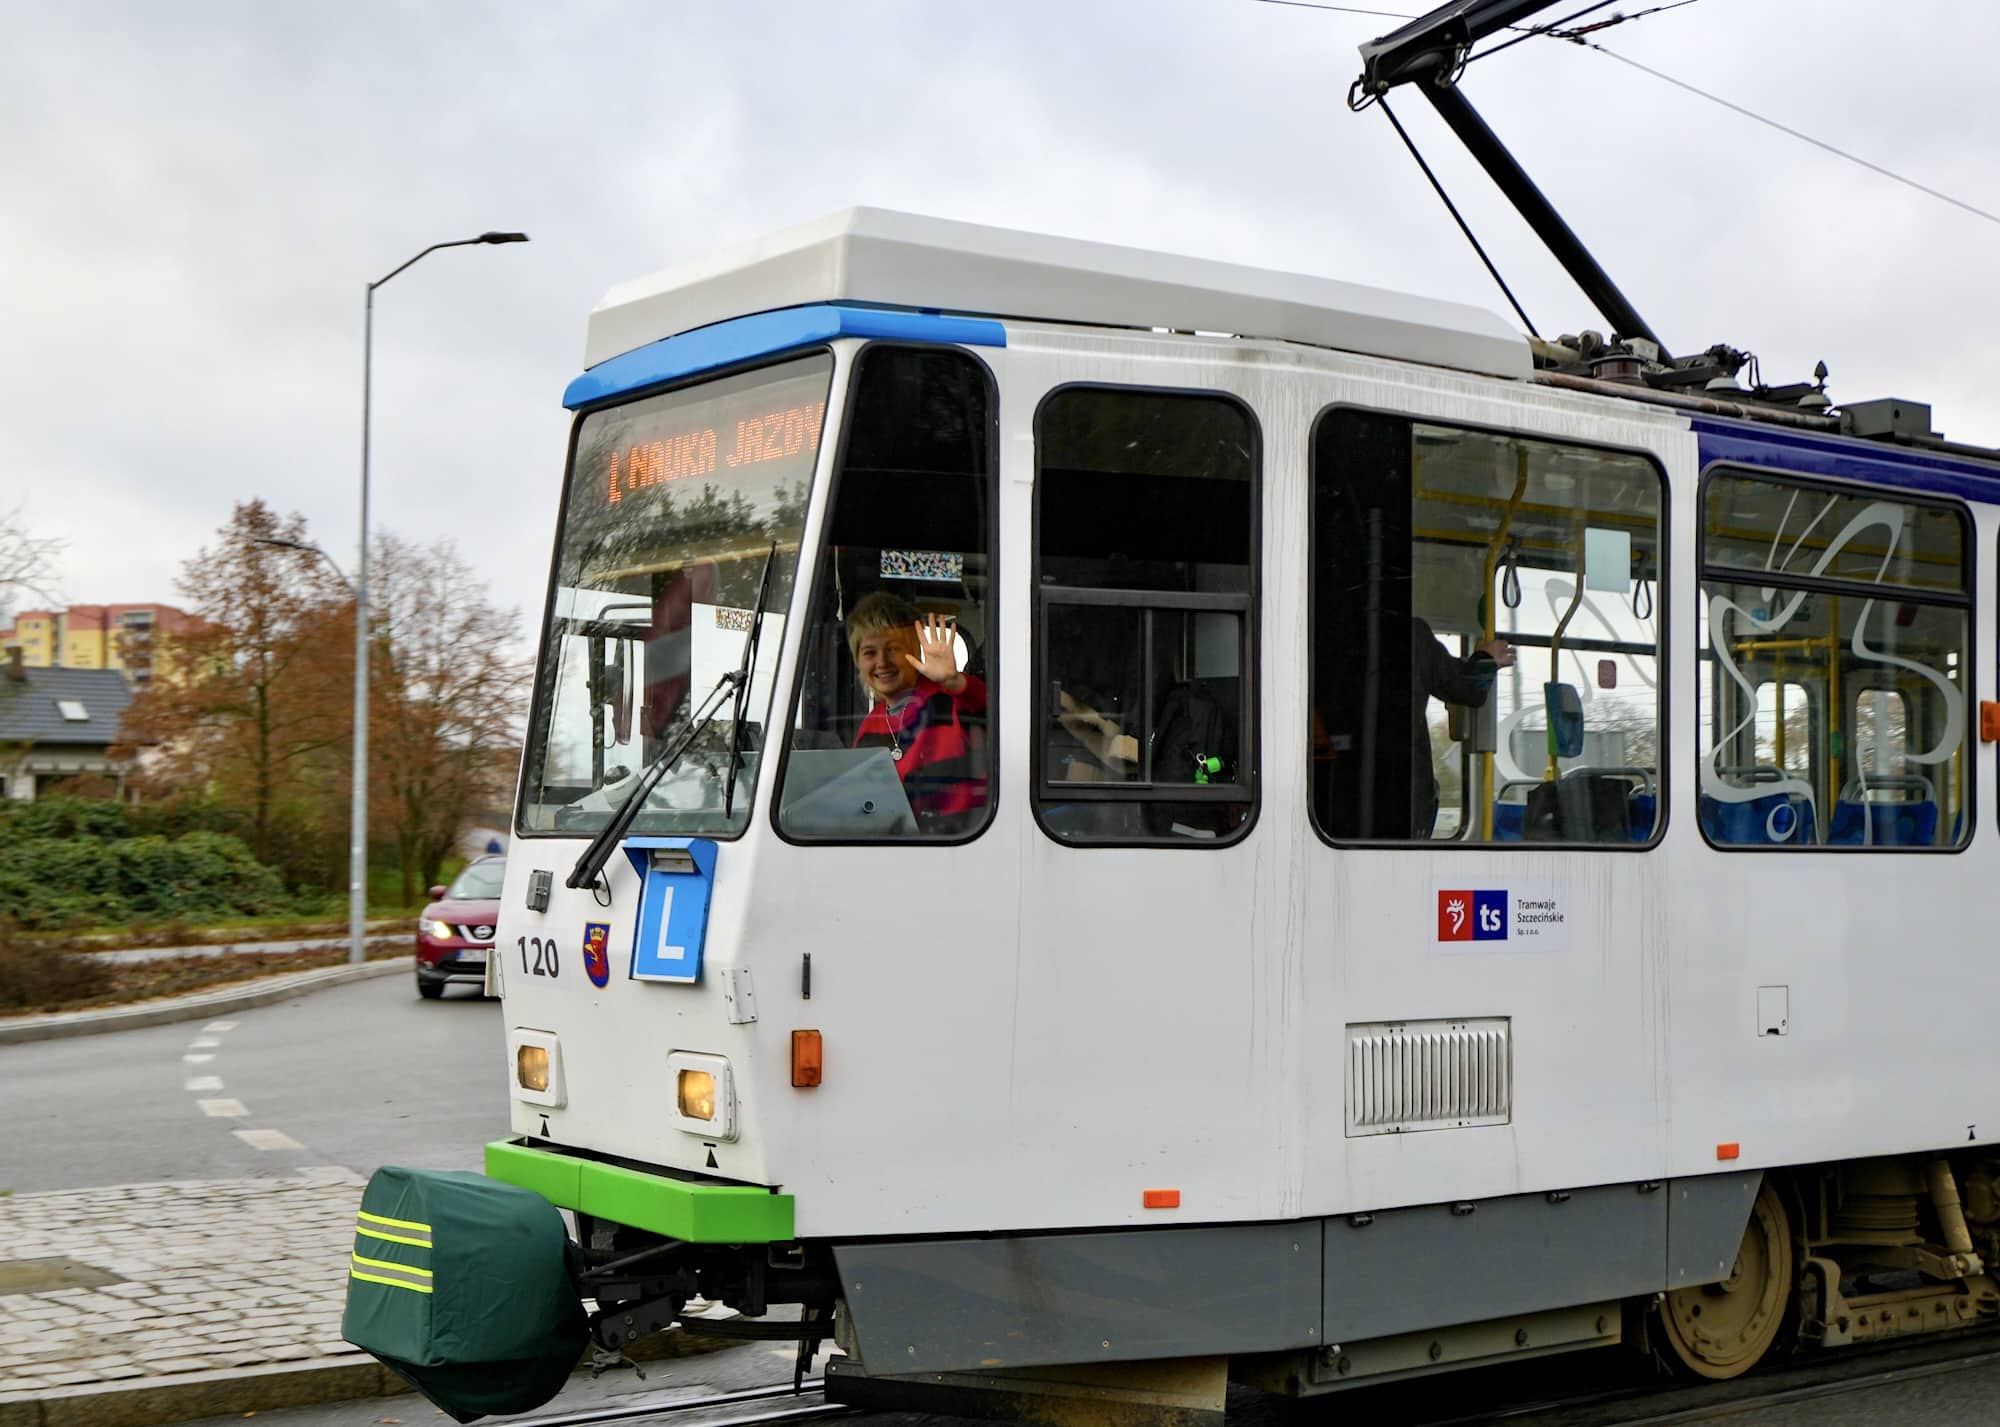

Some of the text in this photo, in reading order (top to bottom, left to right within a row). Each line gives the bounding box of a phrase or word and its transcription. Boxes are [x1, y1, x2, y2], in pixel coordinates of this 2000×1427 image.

[629, 428, 717, 489] NAUKA
[726, 400, 825, 468] JAZDY
[1480, 904, 1501, 931] ts
[1517, 899, 1556, 912] Tramwaje
[1517, 911, 1564, 923] Szczecińskie
[656, 886, 685, 960] L
[518, 936, 559, 978] 120
